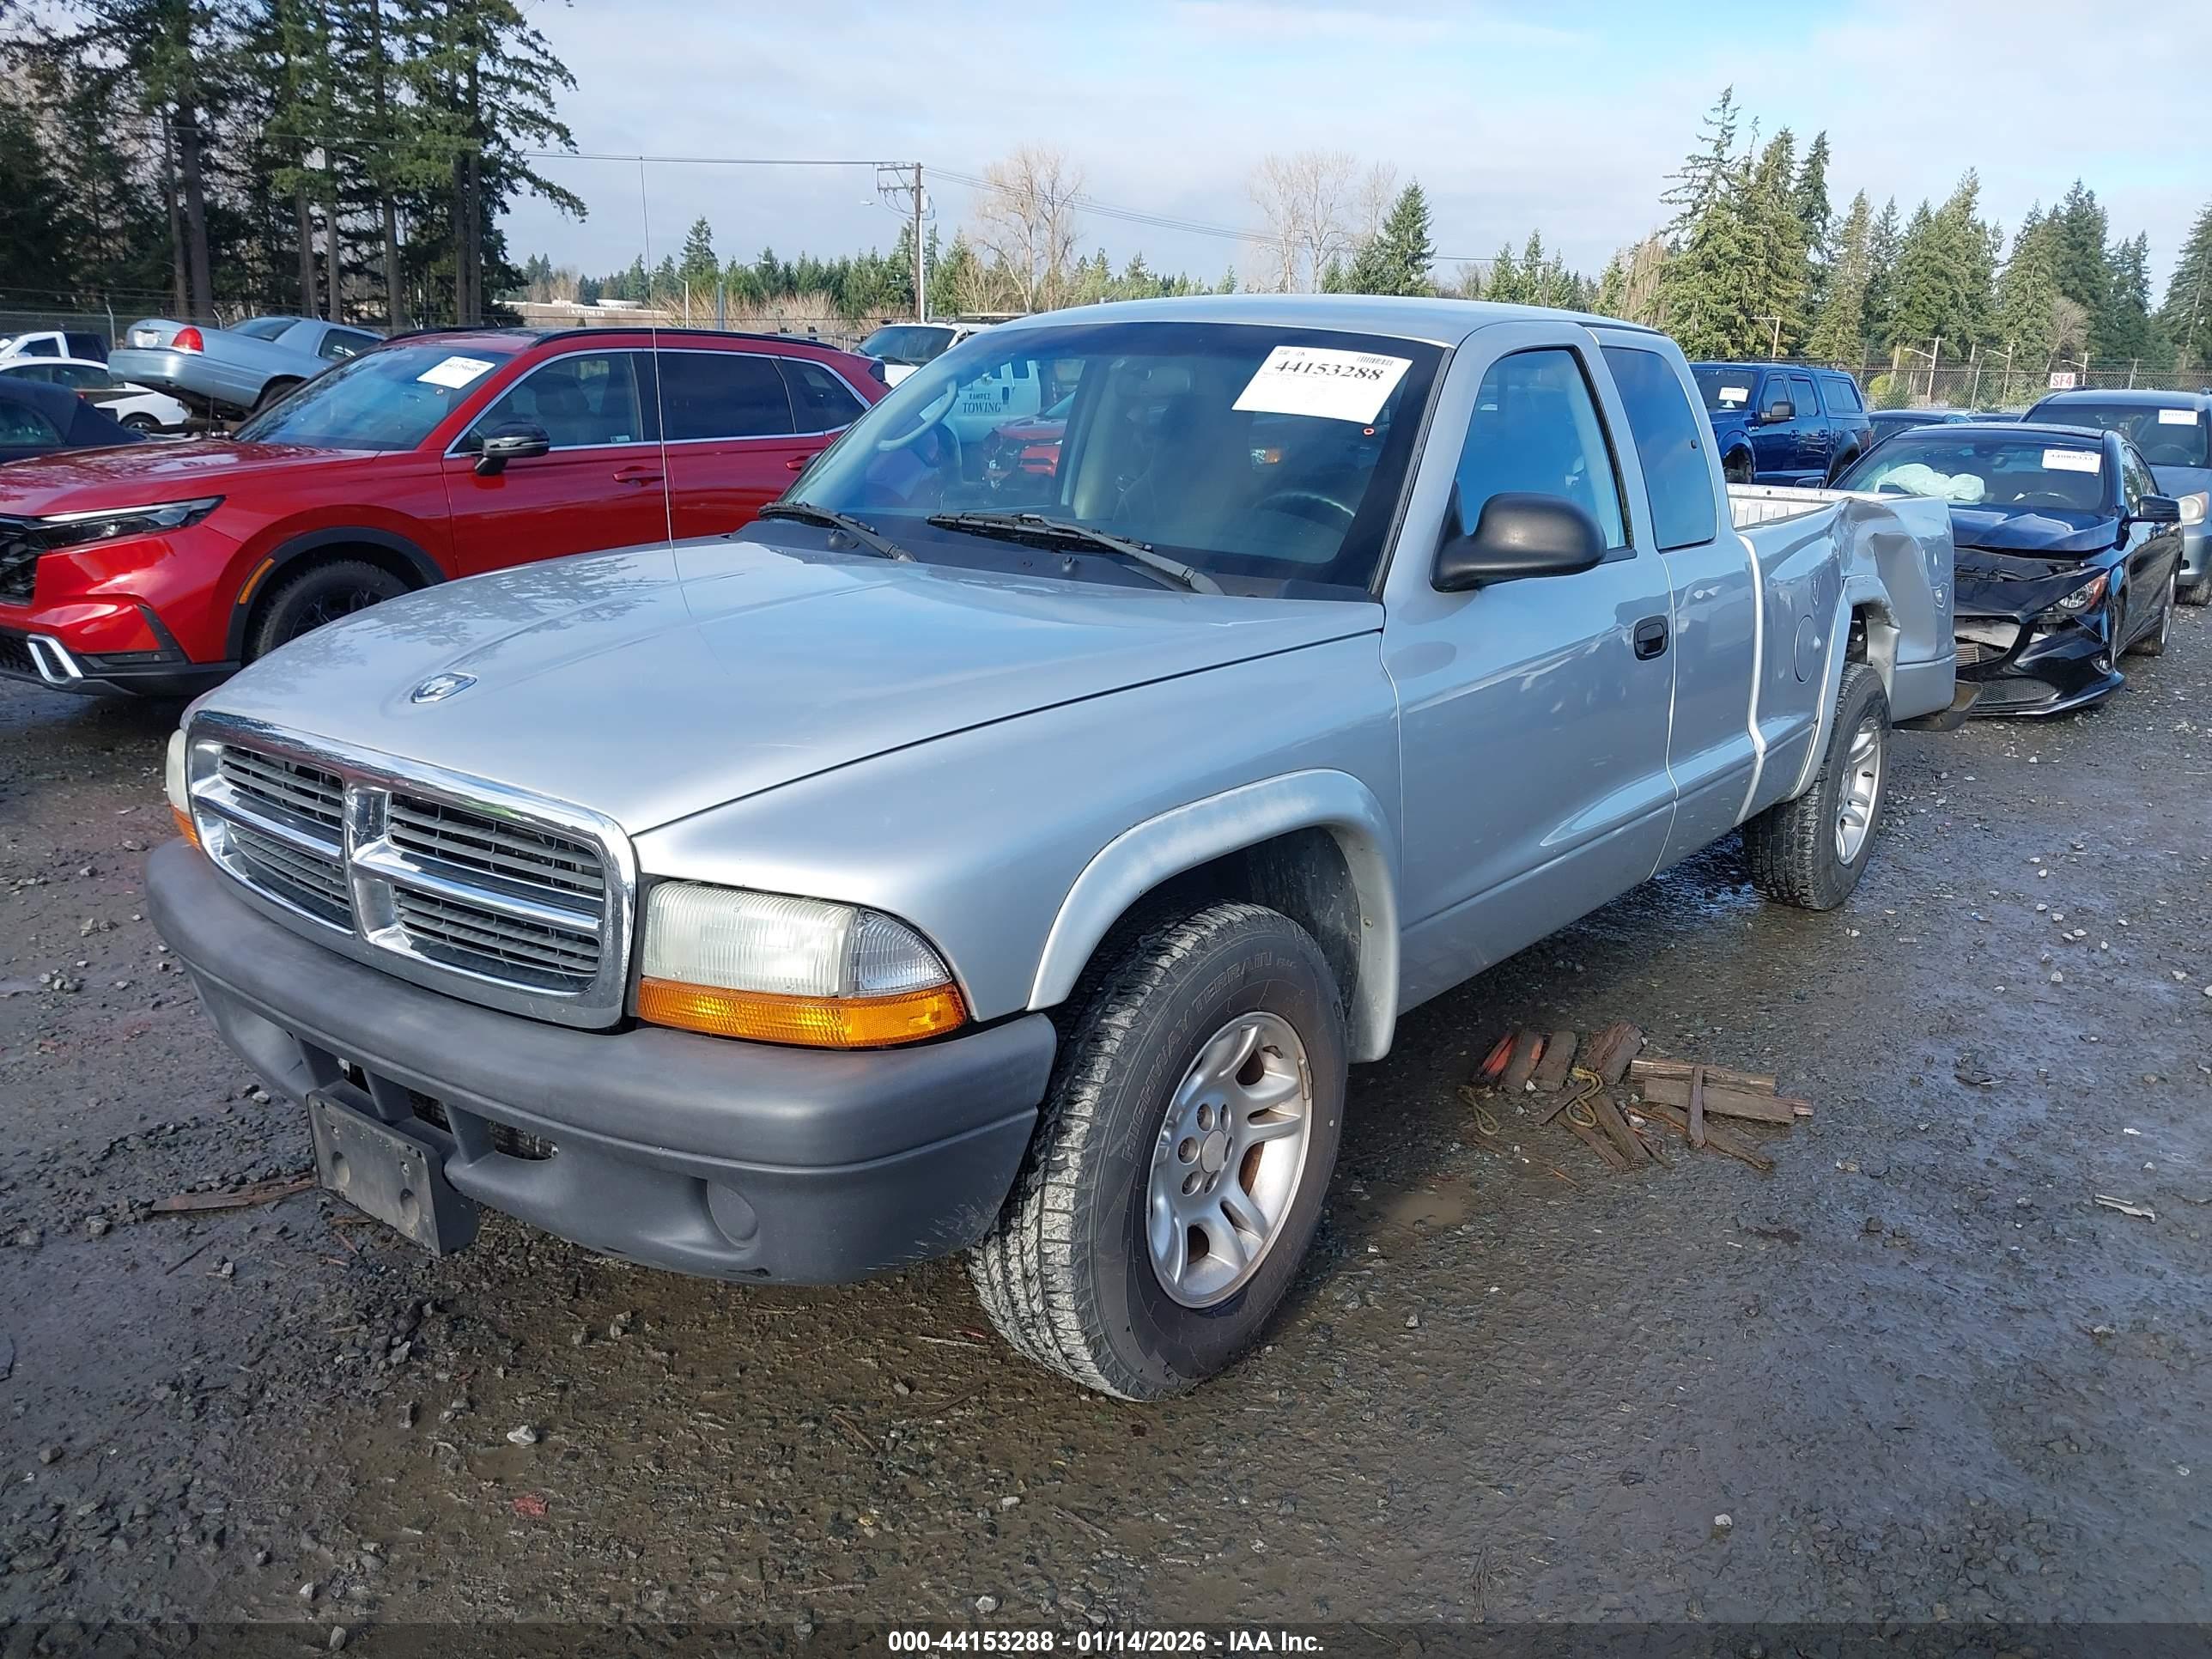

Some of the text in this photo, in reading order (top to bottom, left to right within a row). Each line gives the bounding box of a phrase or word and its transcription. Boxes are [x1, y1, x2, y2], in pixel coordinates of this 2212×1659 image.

[1274, 360, 1384, 381] 44153288
[2052, 374, 2073, 386] SF4
[963, 402, 1002, 413] TOWING
[1121, 951, 1273, 1162] HIGHWAY TERRAIN
